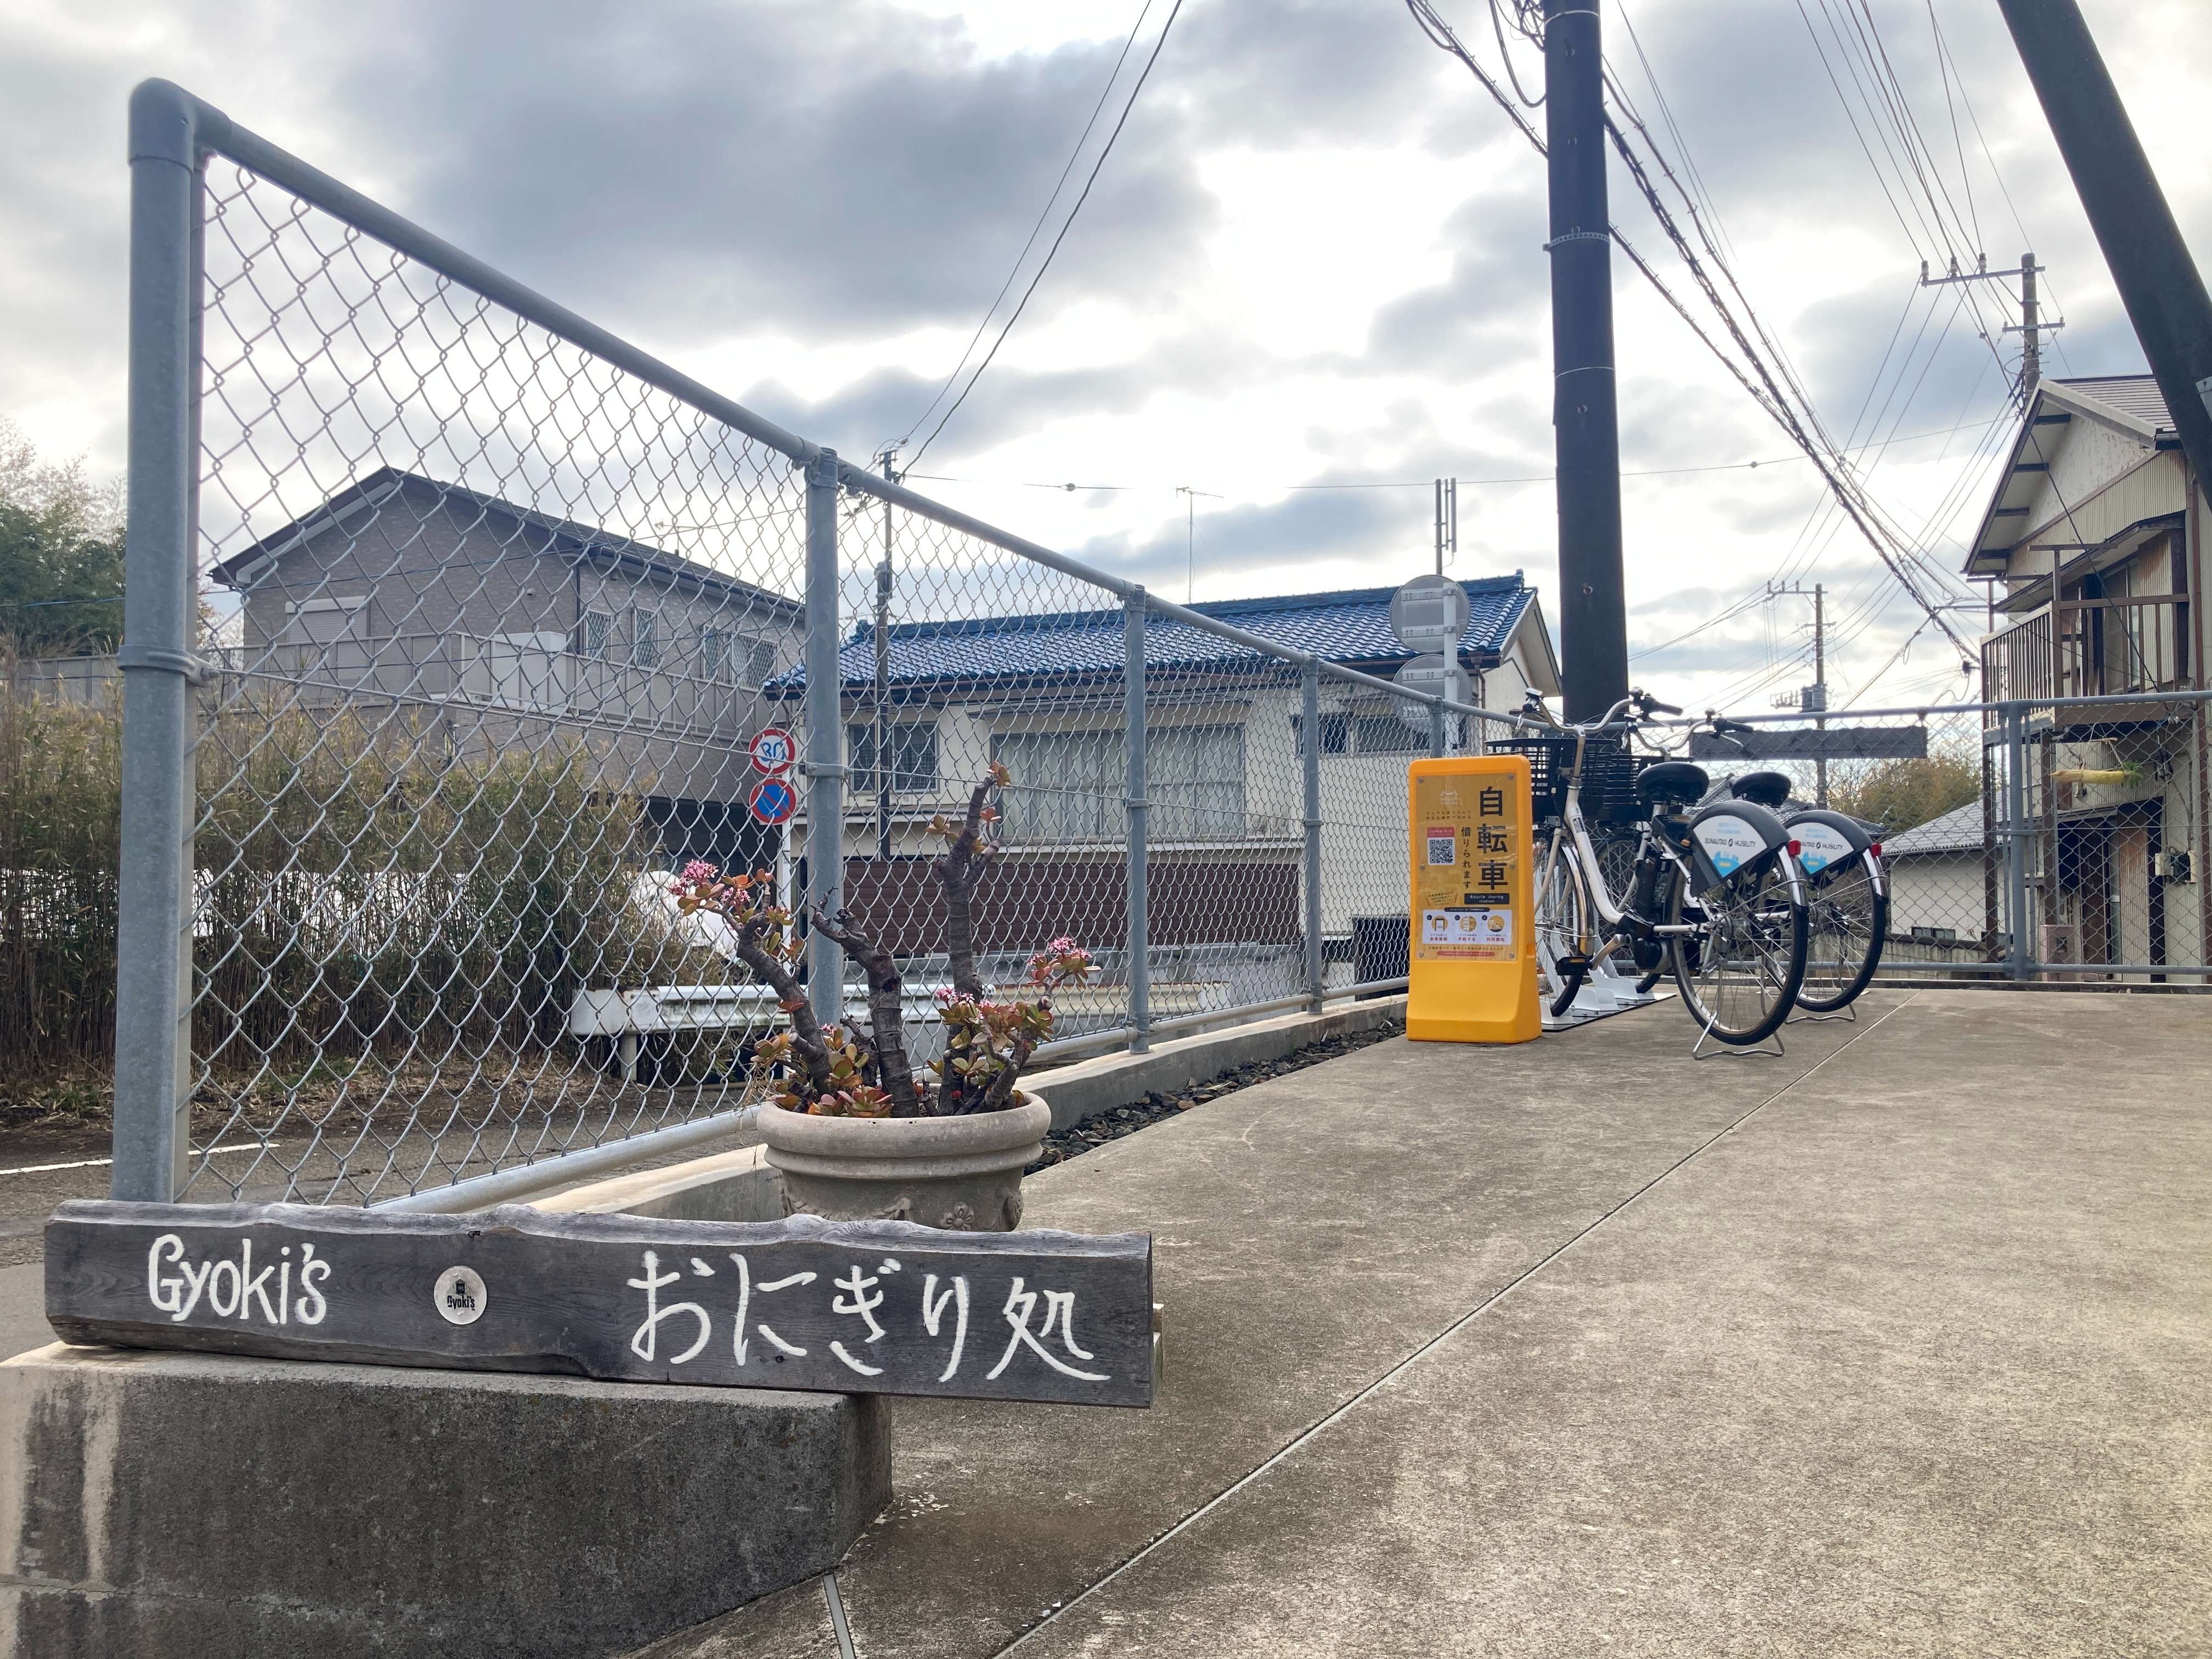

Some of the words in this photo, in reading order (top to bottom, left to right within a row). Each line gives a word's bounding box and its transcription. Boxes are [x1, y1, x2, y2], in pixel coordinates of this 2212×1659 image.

[760, 742, 785, 761] 30
[1462, 826, 1471, 889] 借りられます
[1477, 786, 1508, 890] 自転車
[148, 1234, 331, 1325] Gyoki's
[447, 1295, 475, 1310] Gyoki's
[627, 1251, 1111, 1382] おにぎり処
